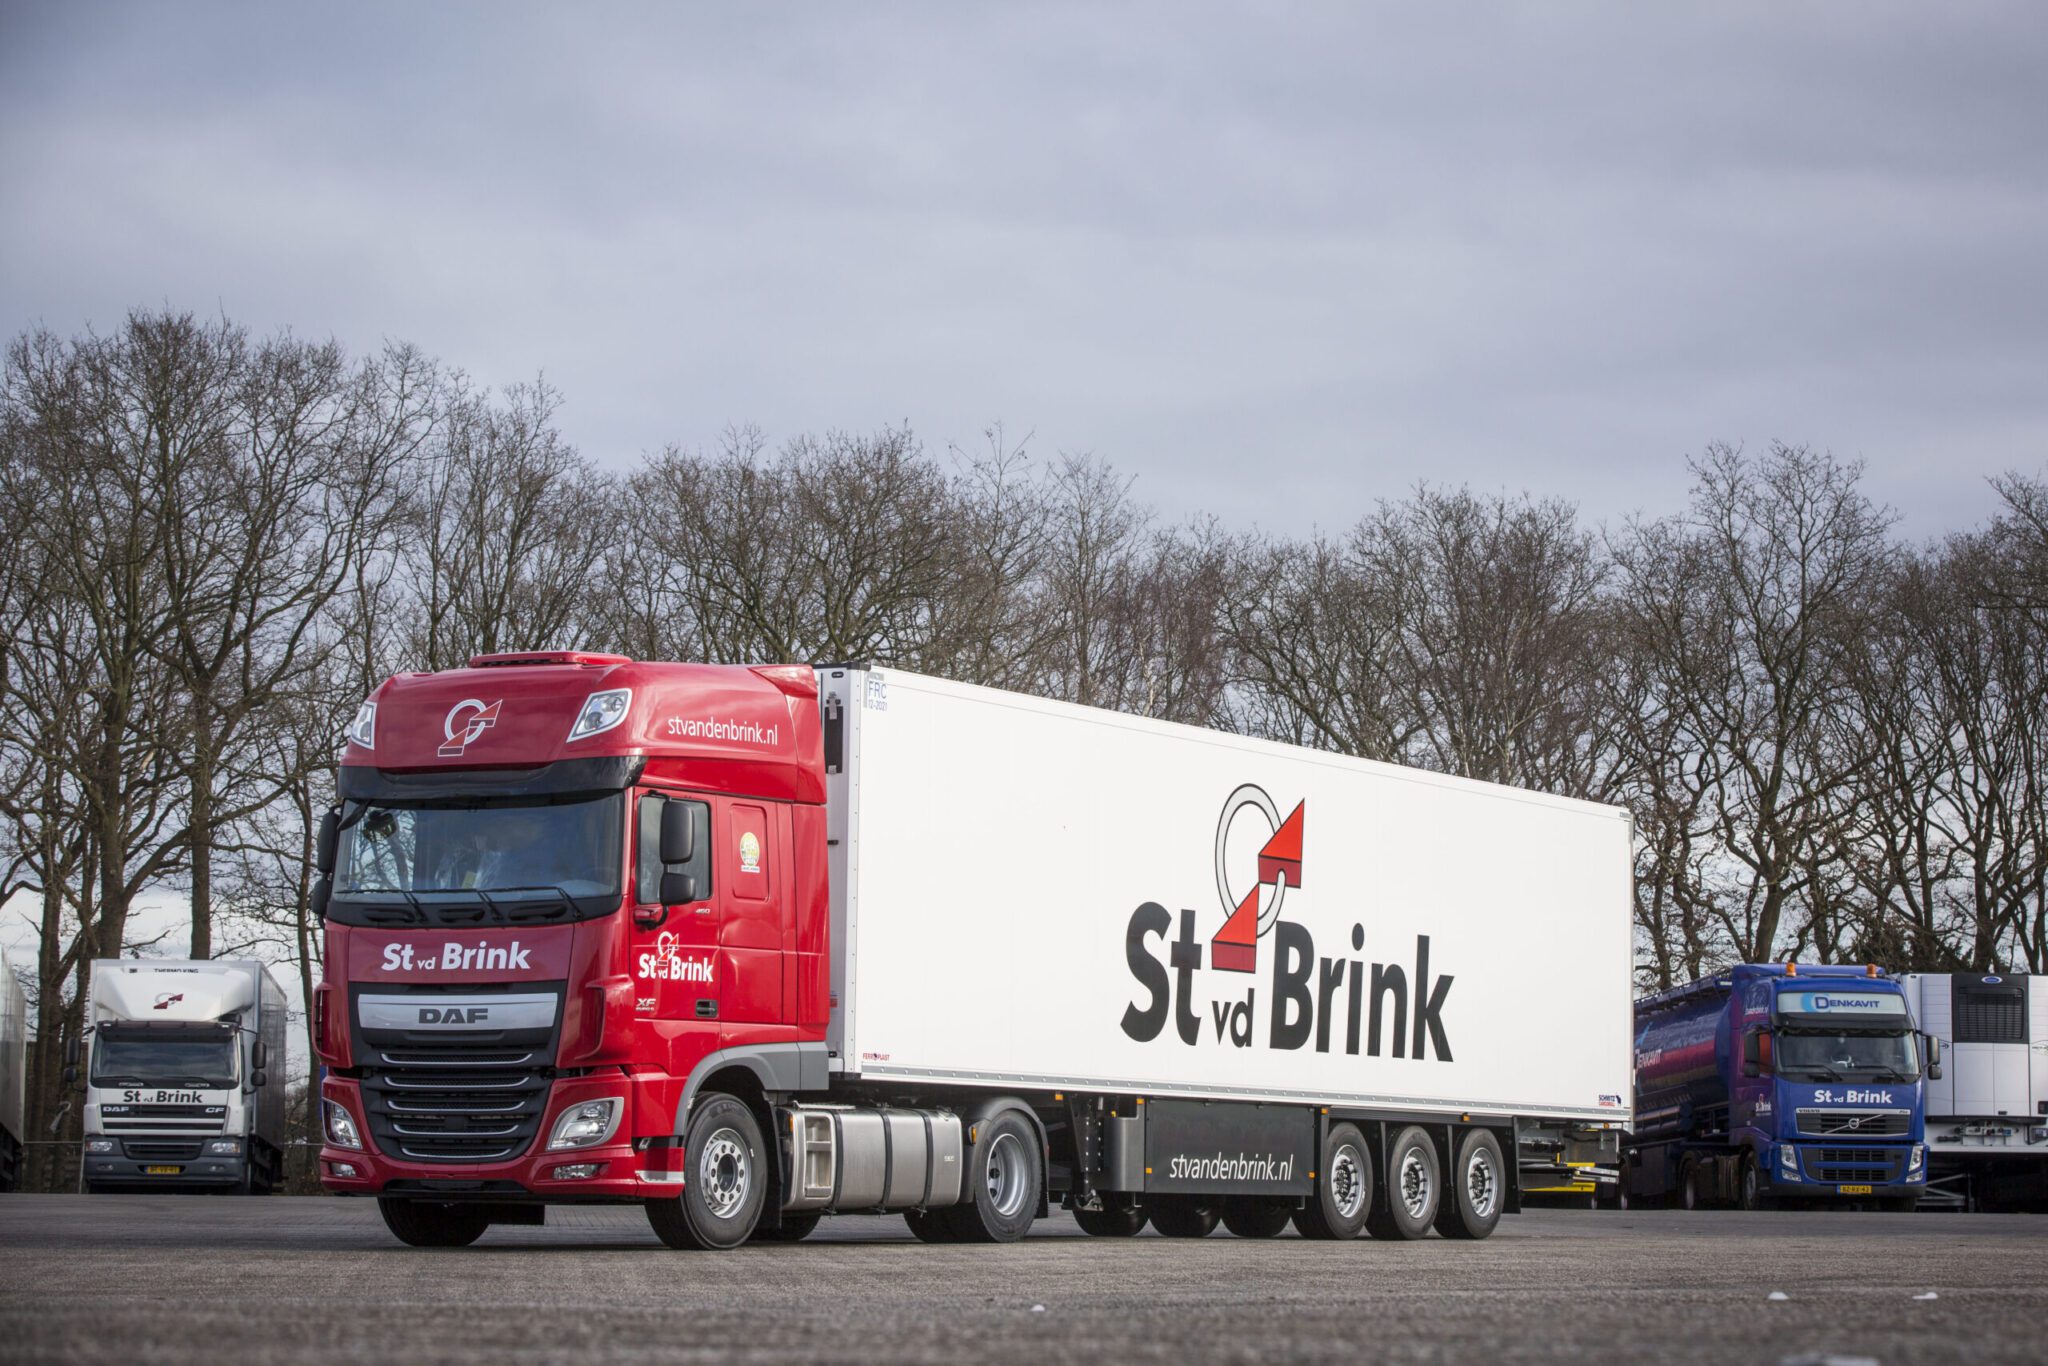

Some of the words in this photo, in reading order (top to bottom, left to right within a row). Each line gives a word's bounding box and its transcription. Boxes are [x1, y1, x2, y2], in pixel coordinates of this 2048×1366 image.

[868, 681, 887, 699] FRC
[667, 715, 778, 746] stvandenbrink.nl
[381, 942, 415, 971] St
[416, 956, 436, 970] vd
[441, 940, 532, 970] Brink
[638, 953, 657, 979] St
[657, 967, 668, 979] vd
[670, 955, 714, 982] Brink
[1120, 901, 1203, 1046] St
[1211, 987, 1255, 1048] vd
[1269, 920, 1455, 1062] Brink
[636, 998, 657, 1007] XF
[1815, 996, 1880, 1010] DENKAVIT
[418, 1008, 489, 1024] DAF
[123, 1090, 141, 1103] St
[156, 1090, 204, 1104] Brink
[1814, 1089, 1833, 1103] St
[1846, 1089, 1893, 1104] Brink
[1169, 1151, 1294, 1181] stvandenbrink.nl
